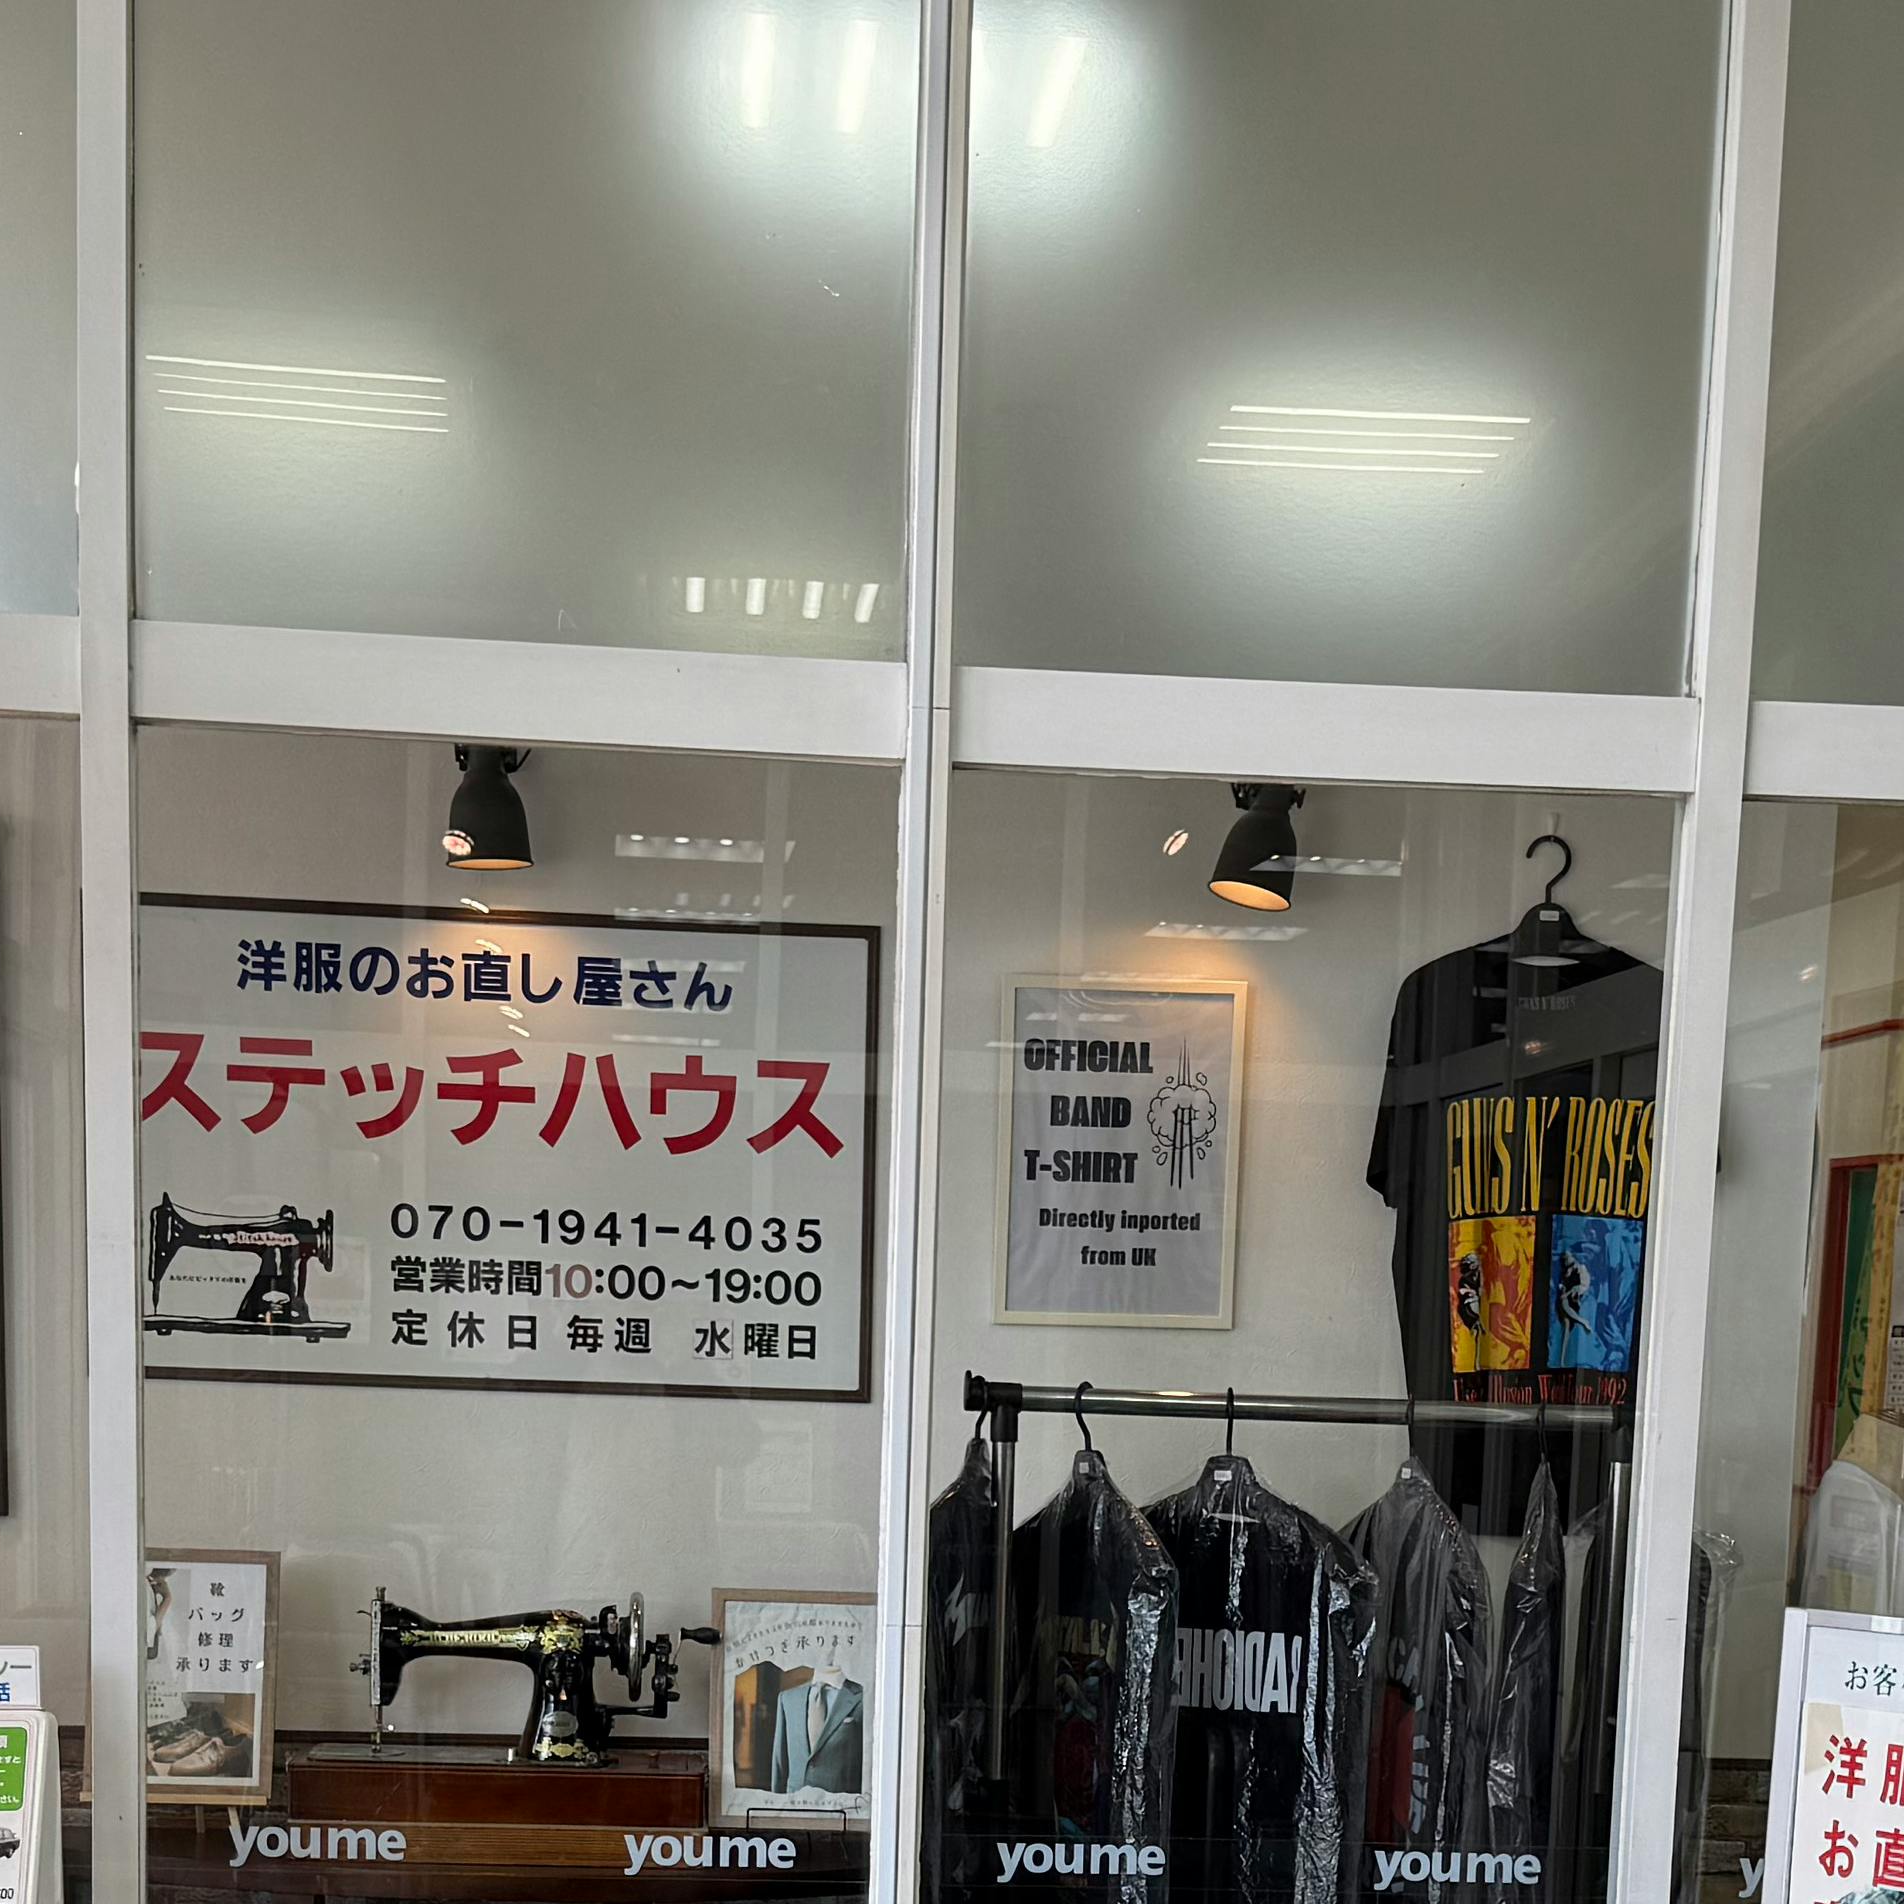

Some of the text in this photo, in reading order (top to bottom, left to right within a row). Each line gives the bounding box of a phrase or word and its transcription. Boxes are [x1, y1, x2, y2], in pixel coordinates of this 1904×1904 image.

[237, 938, 735, 1013] 洋服のお直し屋さん
[1024, 1037, 1153, 1075] OFFICIAL
[140, 1030, 845, 1159] ステッチハウス
[1050, 1095, 1132, 1129] BAND
[1024, 1149, 1139, 1185] T-SHIRT
[1447, 1097, 1514, 1219] GUNS
[1561, 1096, 1656, 1220] ROSES
[390, 1203, 824, 1254] 070-1941-4035
[1039, 1206, 1201, 1234] Directly inported
[1081, 1245, 1157, 1268] from UK
[391, 1308, 539, 1351] 定休日
[566, 1316, 653, 1355] 毎週
[188, 1607, 245, 1622] バッグ
[198, 1632, 234, 1648] 修理
[176, 1657, 254, 1673] 承ります
[229, 1820, 407, 1868] youme
[624, 1830, 797, 1876] youme
[996, 1840, 1167, 1884] youme
[1373, 1846, 1542, 1891] youme
